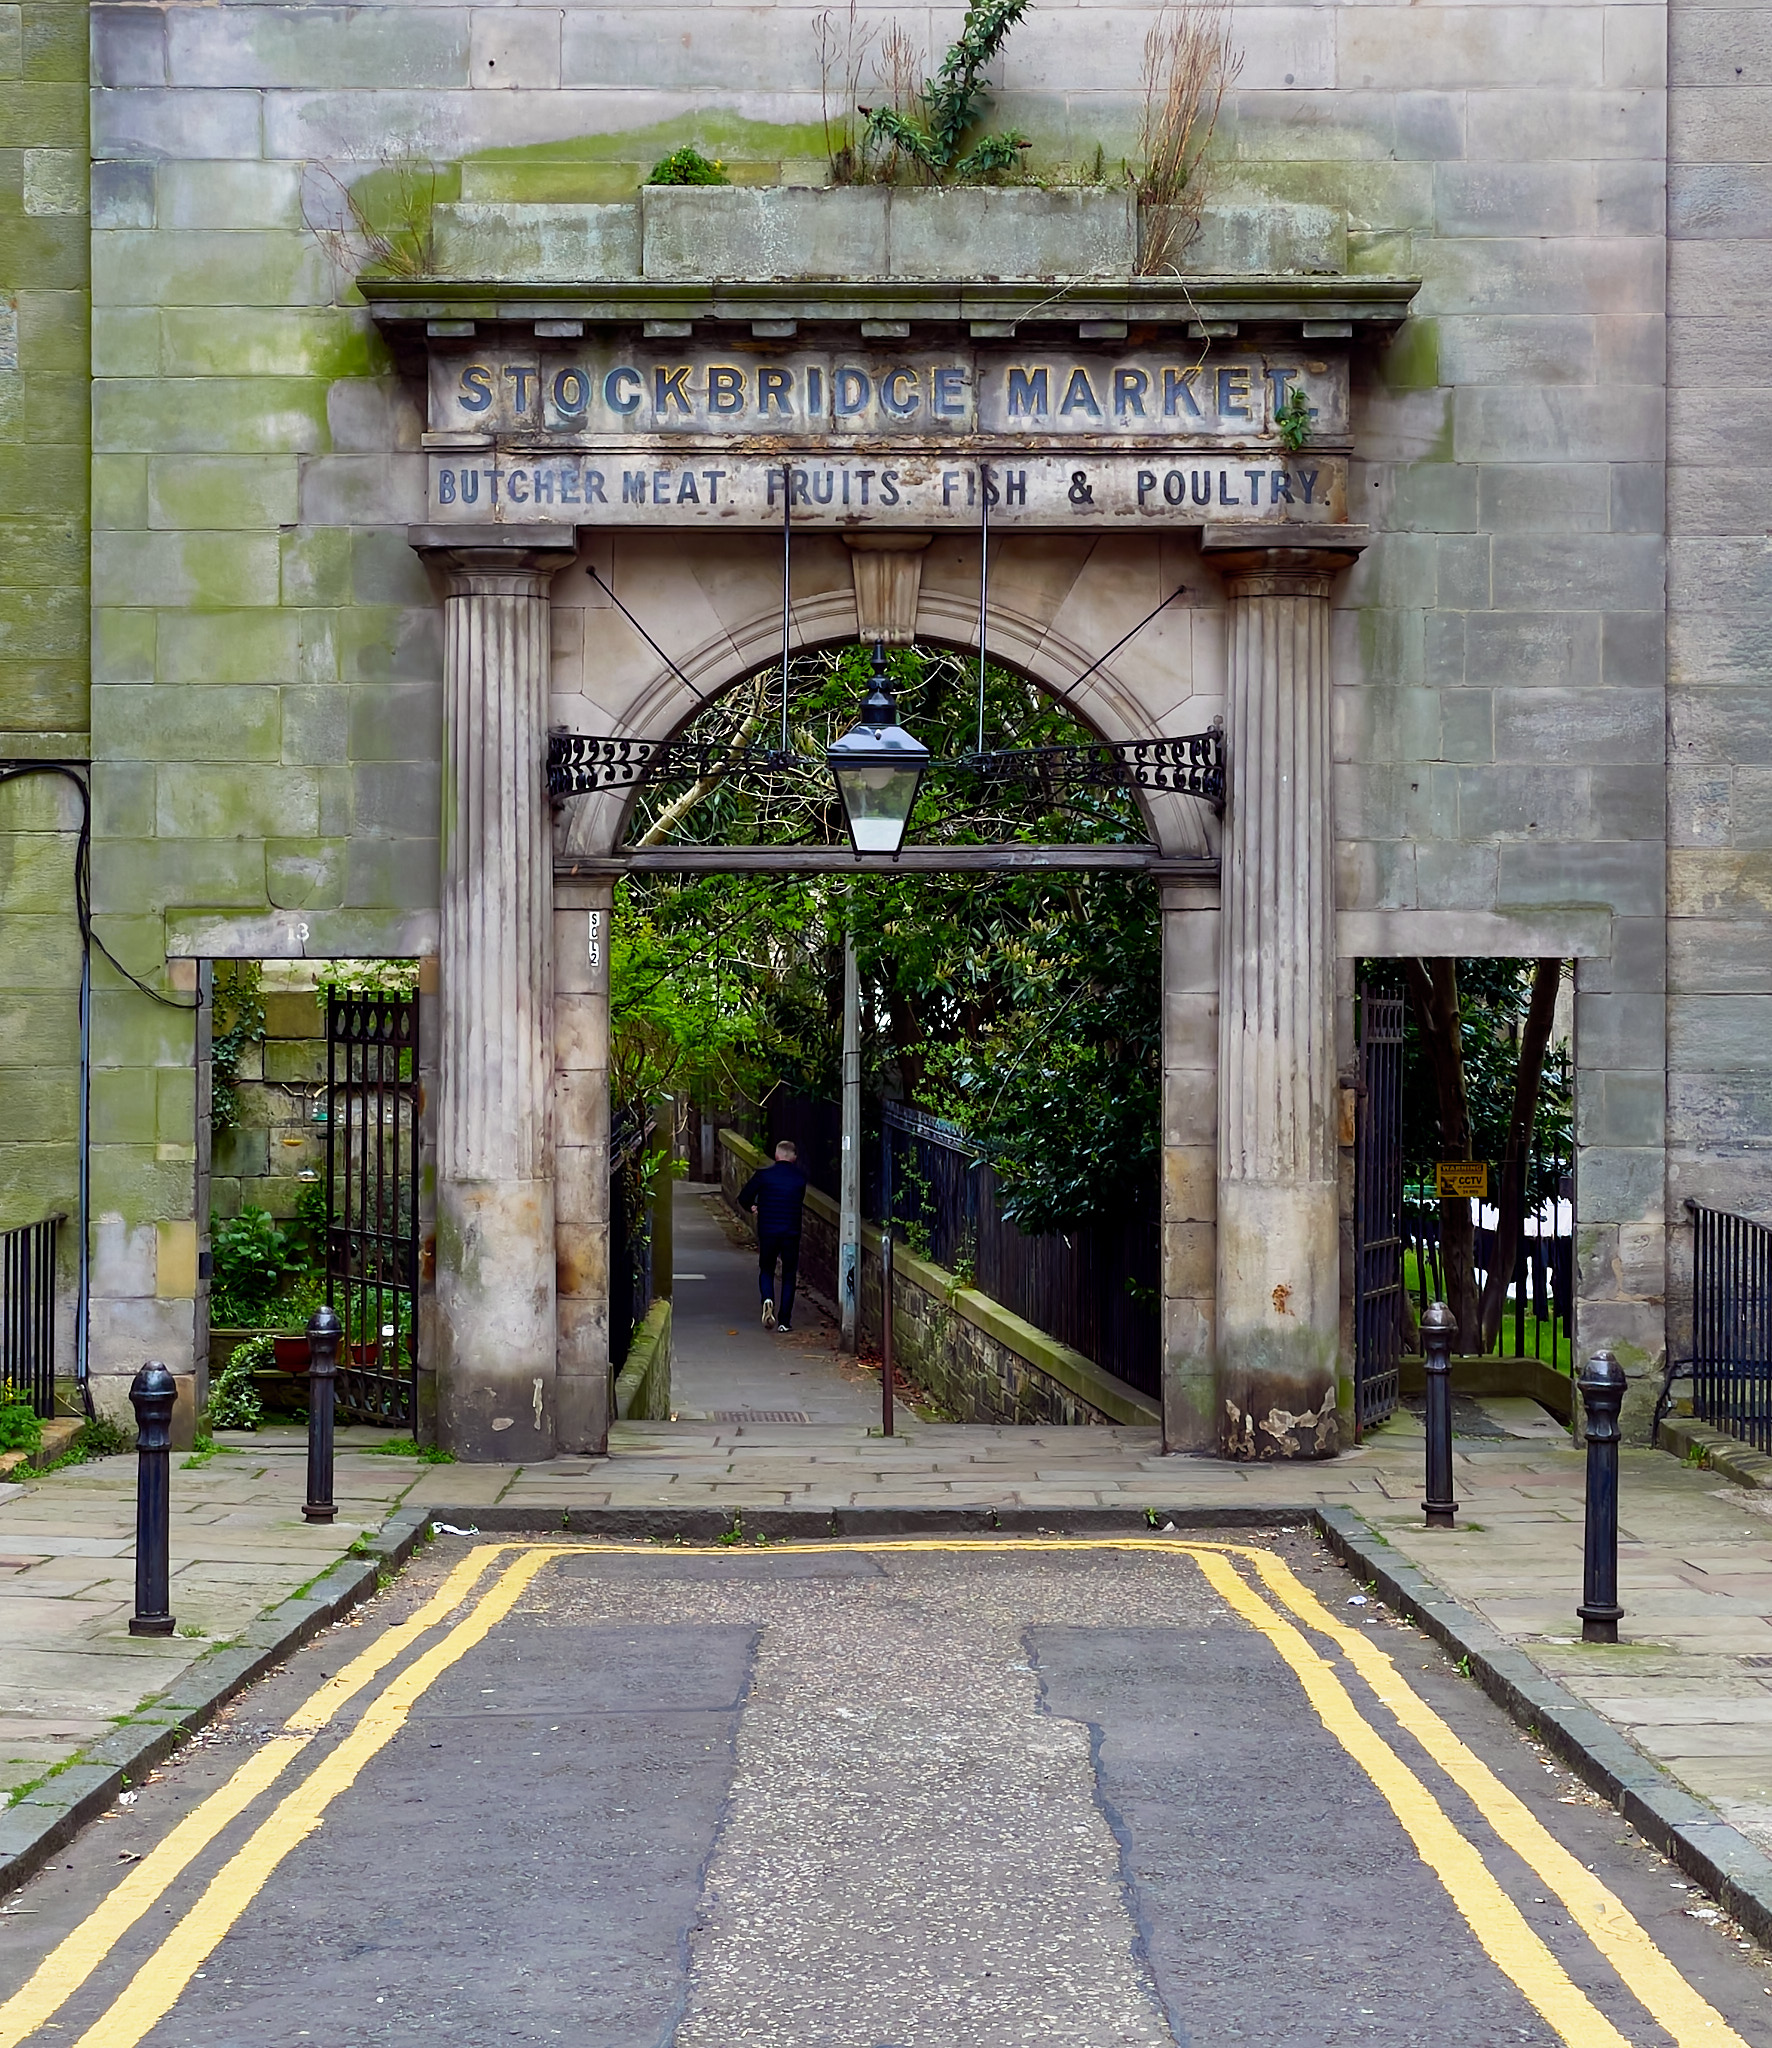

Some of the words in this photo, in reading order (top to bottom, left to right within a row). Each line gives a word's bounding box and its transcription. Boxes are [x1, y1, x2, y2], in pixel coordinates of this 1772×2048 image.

[457, 365, 966, 416] STOCKBRIDGE
[439, 469, 608, 505] BUTCHER
[622, 470, 736, 505] MEAT.
[942, 470, 1027, 506] FISH
[1067, 470, 1095, 505] &
[287, 922, 310, 942] 13
[1458, 1176, 1482, 1185] CCTV
